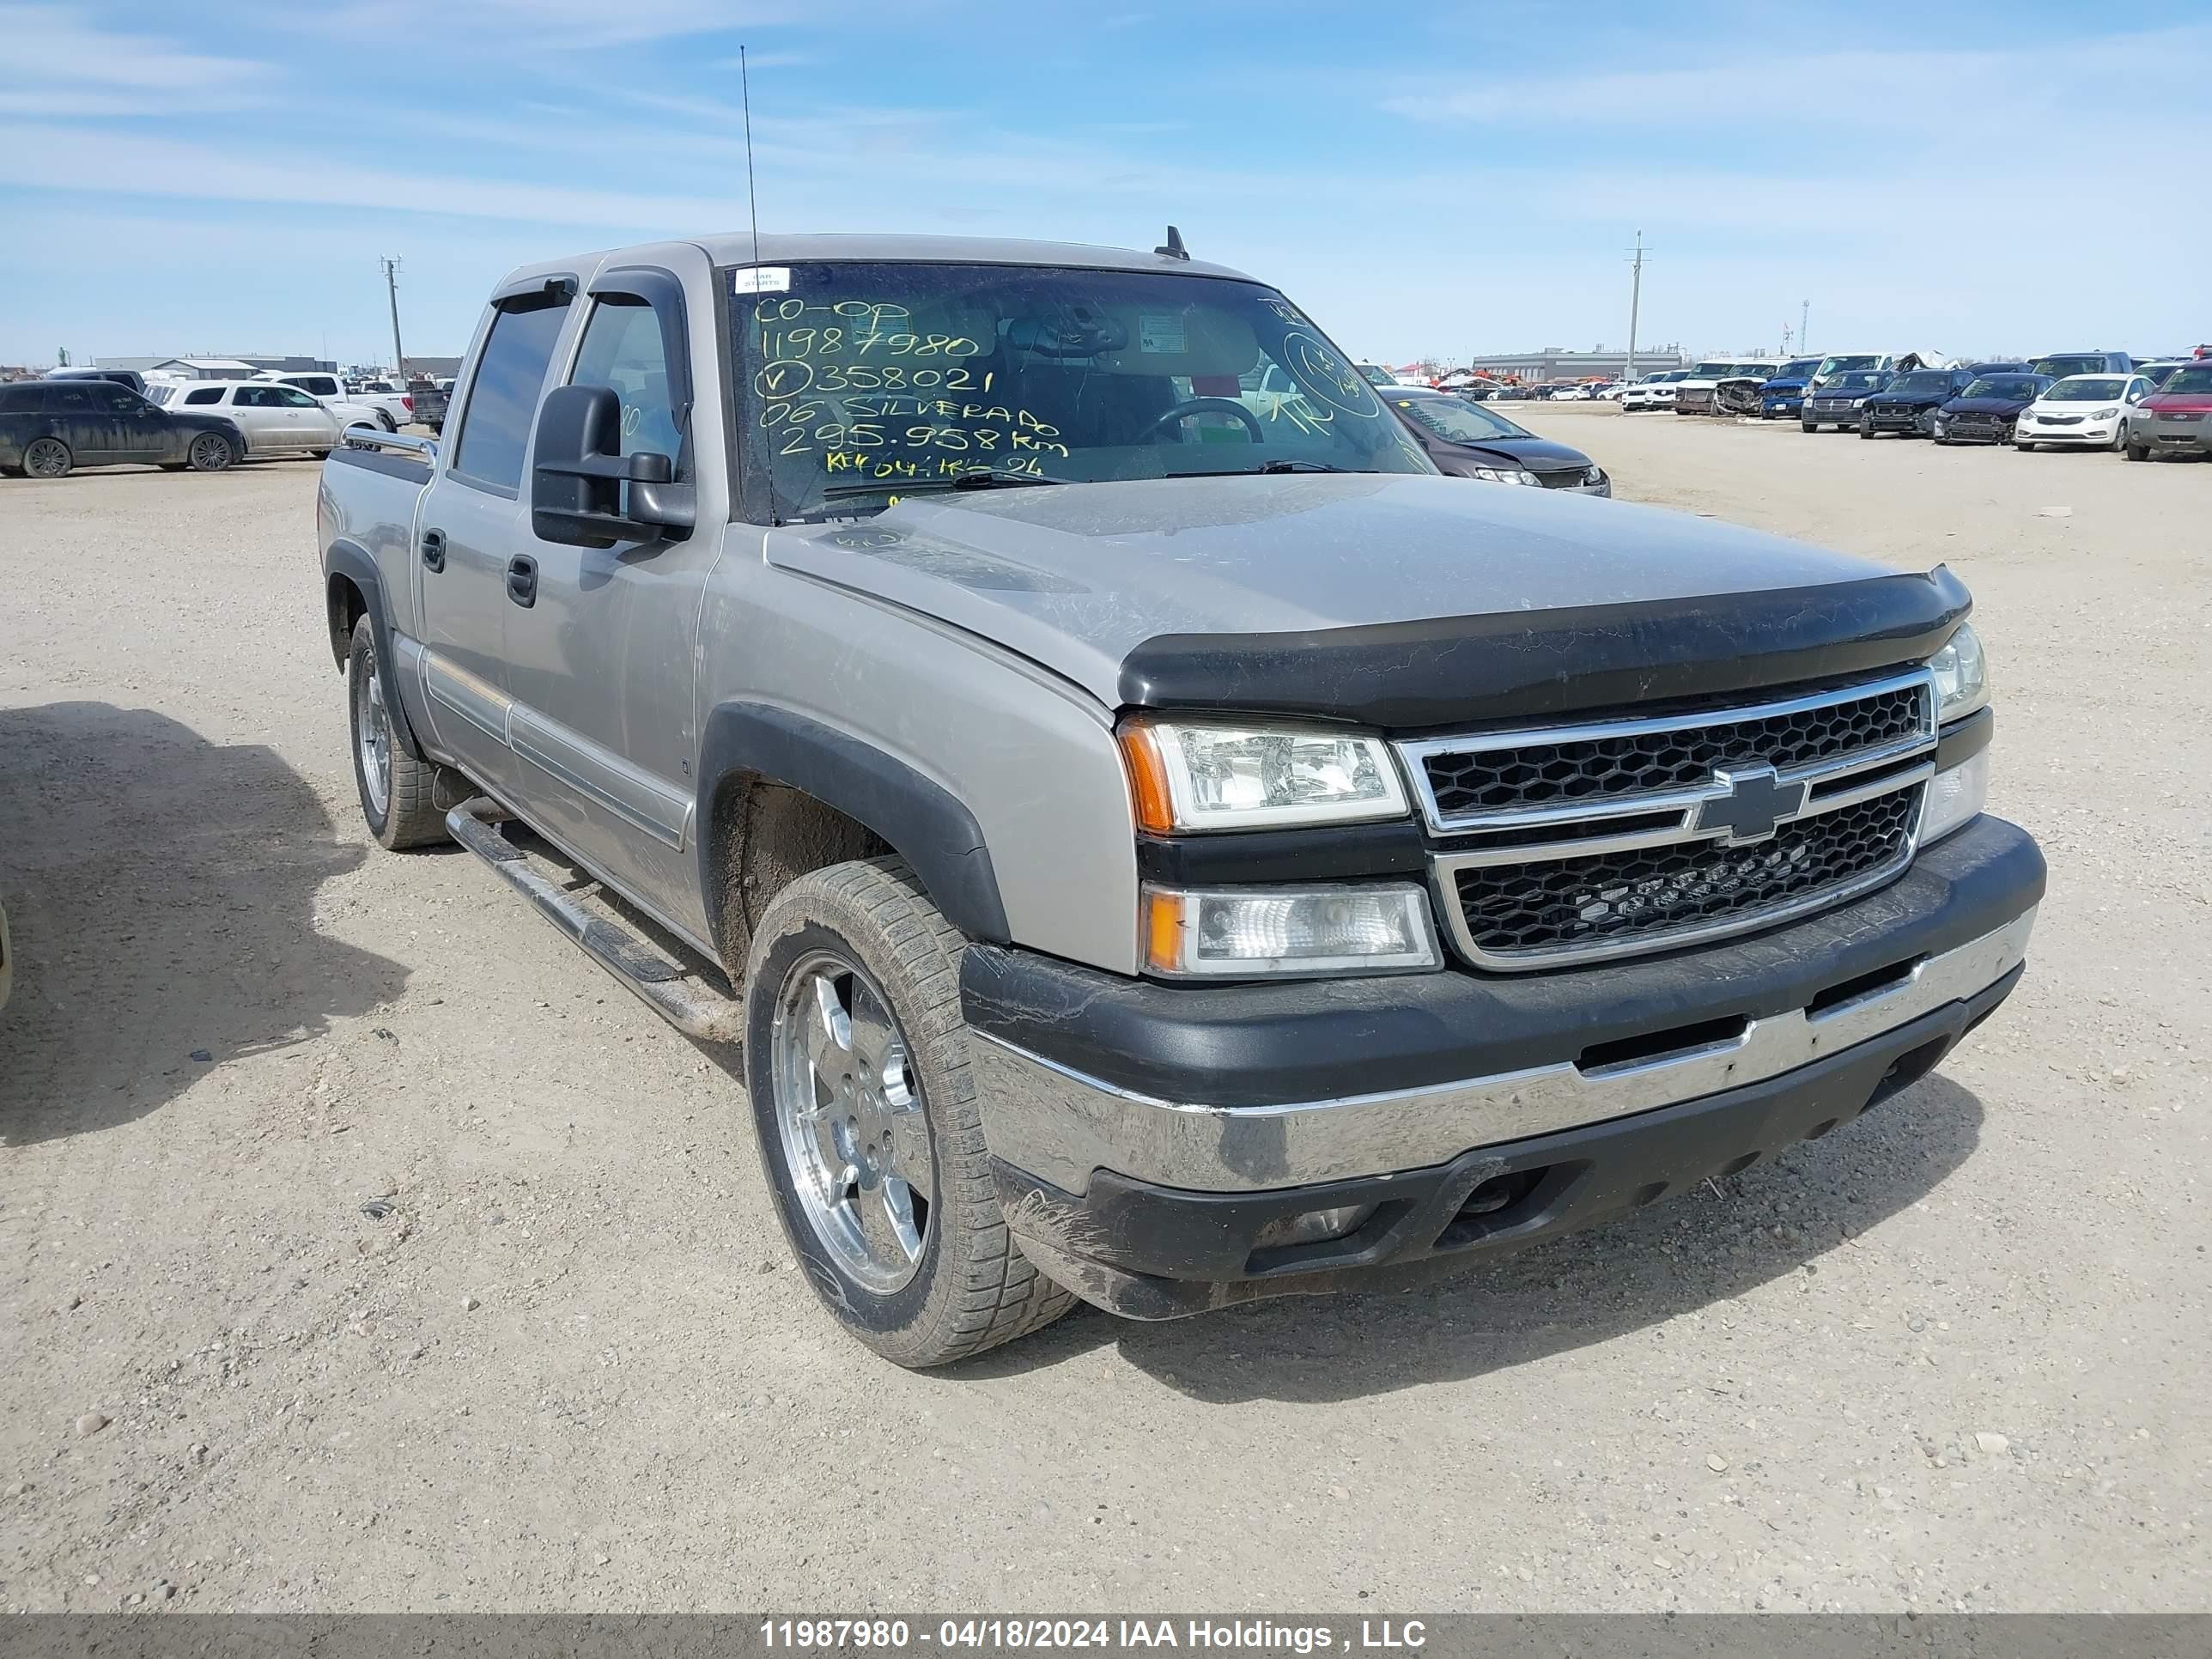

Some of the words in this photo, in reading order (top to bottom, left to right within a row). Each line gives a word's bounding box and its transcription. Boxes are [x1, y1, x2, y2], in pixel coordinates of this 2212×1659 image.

[763, 327, 980, 359] 11987980
[816, 366, 994, 393] 358021
[759, 401, 826, 428] 06
